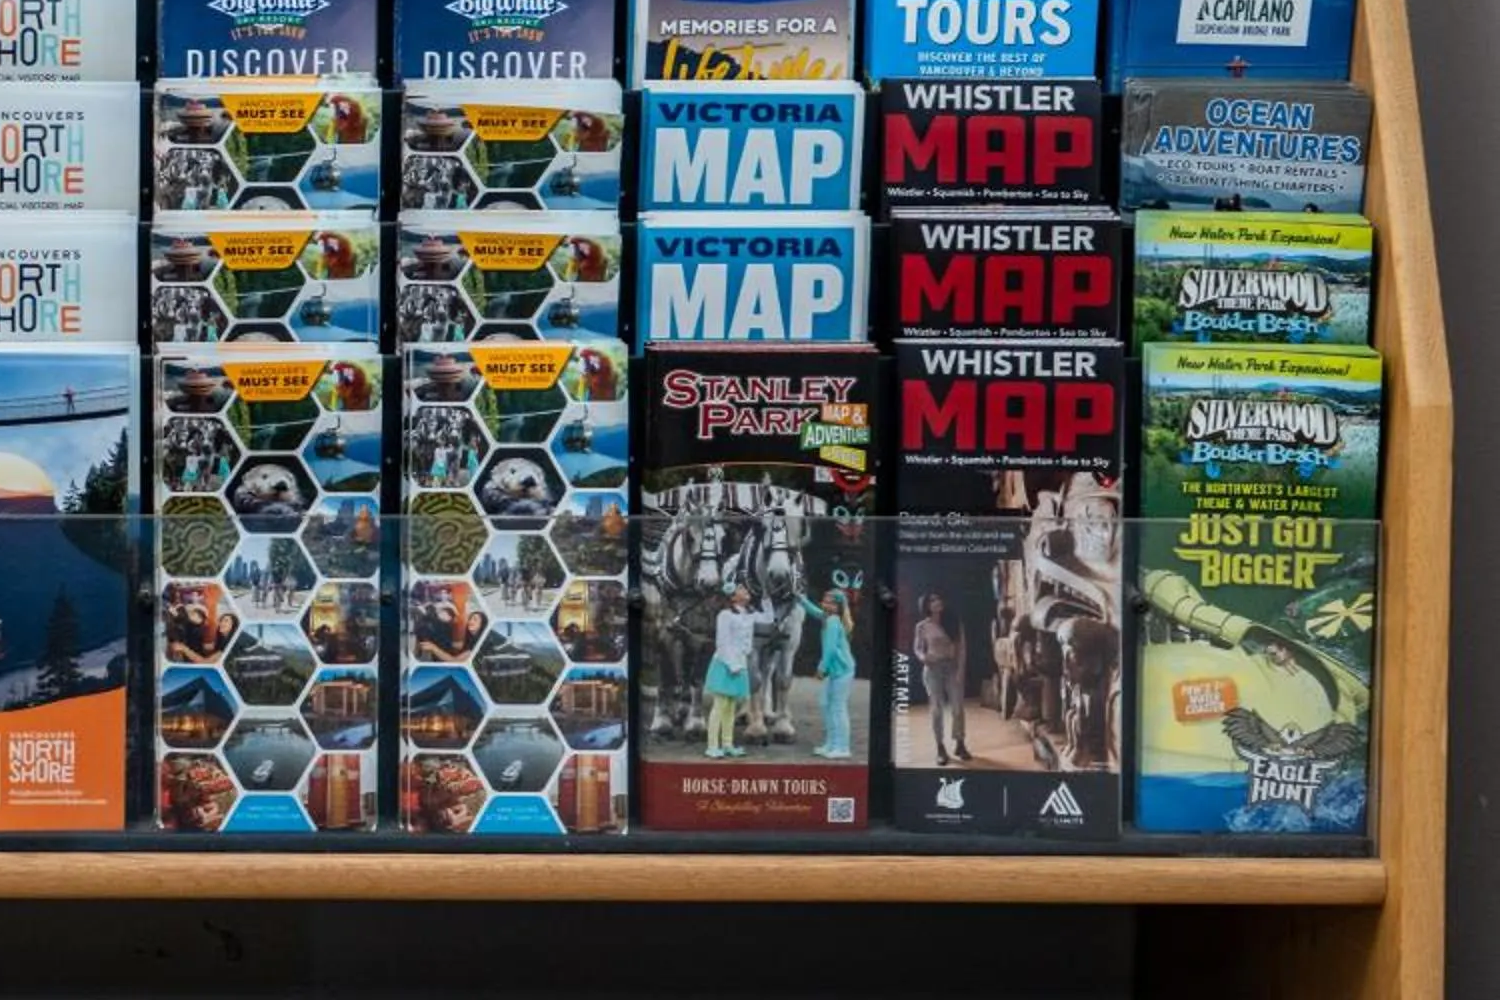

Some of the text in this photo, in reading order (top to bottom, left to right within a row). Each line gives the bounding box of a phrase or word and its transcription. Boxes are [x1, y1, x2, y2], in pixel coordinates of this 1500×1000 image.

[660, 18, 837, 36] MEMORIES FOR A
[903, 84, 1076, 112] WHISTLER
[659, 103, 843, 123] VICTORIA
[1206, 97, 1314, 130] OCEAN
[884, 113, 1093, 185] MAP
[1154, 126, 1361, 165] ADVENTURES
[653, 127, 844, 205] MAP
[1167, 159, 1338, 178] ECO TOURS BOAT RENTALS
[1273, 181, 1335, 193] CHARTERS
[1169, 226, 1340, 245] New Water Park Expansion!
[224, 246, 295, 256] MUST SEE
[1179, 268, 1328, 313] SILVERWOOD
[1256, 299, 1287, 311] PARK
[1184, 311, 1319, 334] Boulder Beach
[664, 369, 857, 408] STANLEY
[698, 401, 820, 440] PARK
[1182, 481, 1339, 499] THE NORTHWEST'S LARGEST
[1196, 497, 1232, 509] THEME
[1249, 498, 1288, 511] WATER
[1291, 499, 1322, 512] PARK
[1179, 515, 1335, 549] JUST GOT
[1173, 548, 1344, 590] BIGGER
[9, 740, 75, 765] NORTH
[9, 758, 75, 783] SHORE
[1253, 756, 1339, 783] EAGLE
[682, 778, 827, 795] HORSE-DRAWN TOURS
[1252, 780, 1320, 806] HUNT
